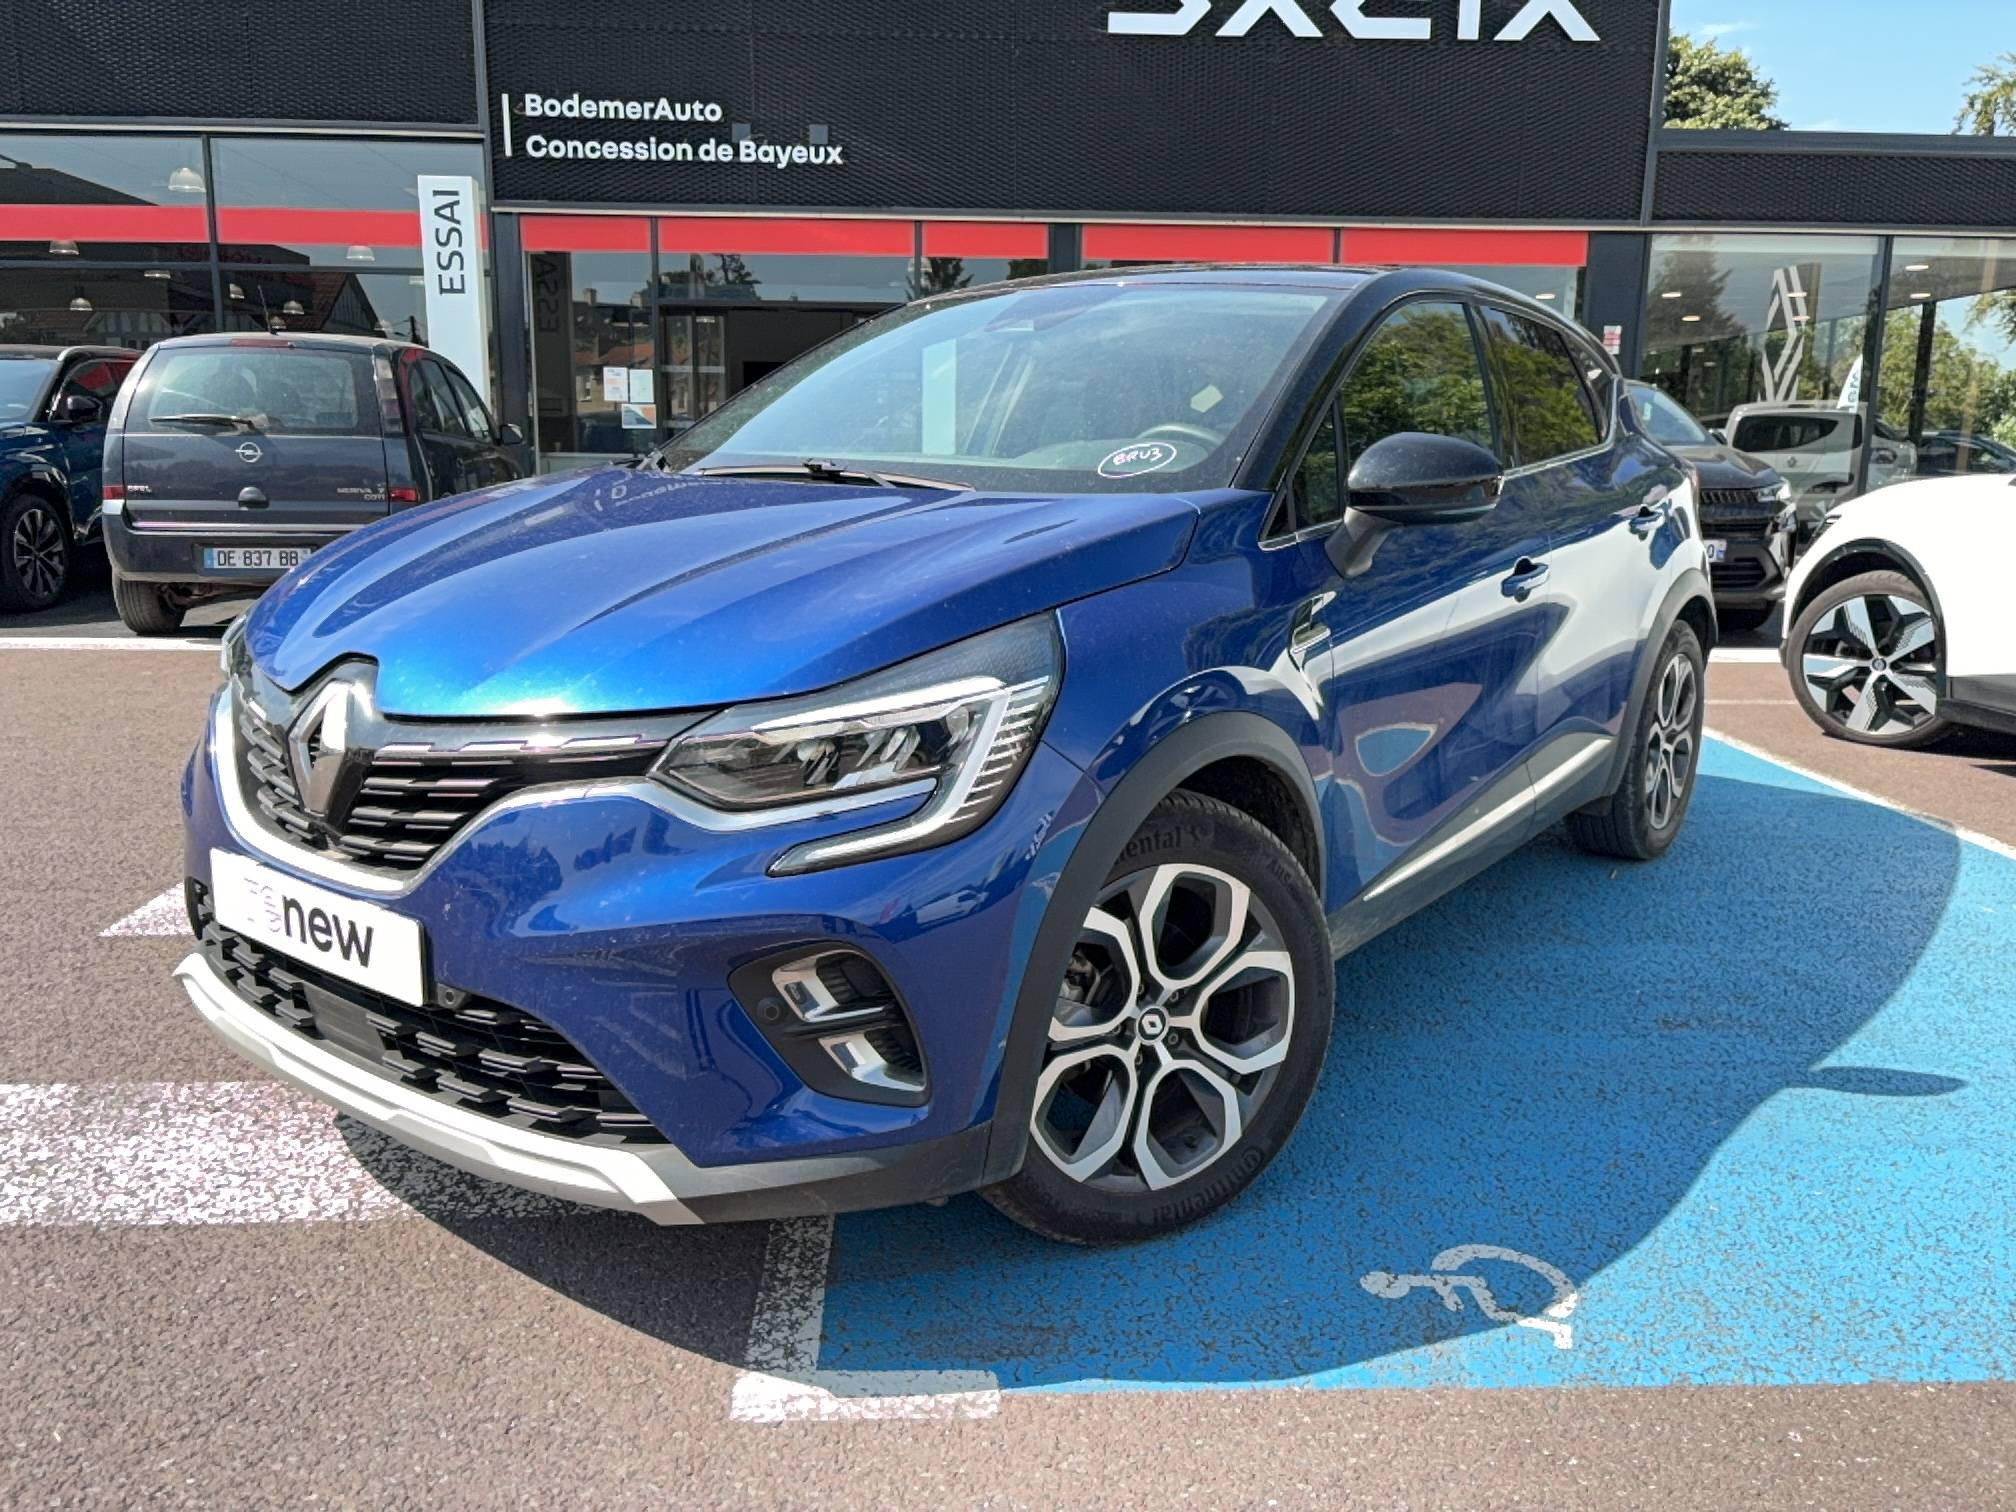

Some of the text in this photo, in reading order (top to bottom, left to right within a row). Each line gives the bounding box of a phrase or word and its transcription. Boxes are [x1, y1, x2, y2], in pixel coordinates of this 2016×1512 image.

[524, 93, 724, 123] BodemerAuto
[525, 134, 844, 169] Concession de Bayeux
[433, 189, 465, 295] ESSAI
[243, 550, 272, 567] 837
